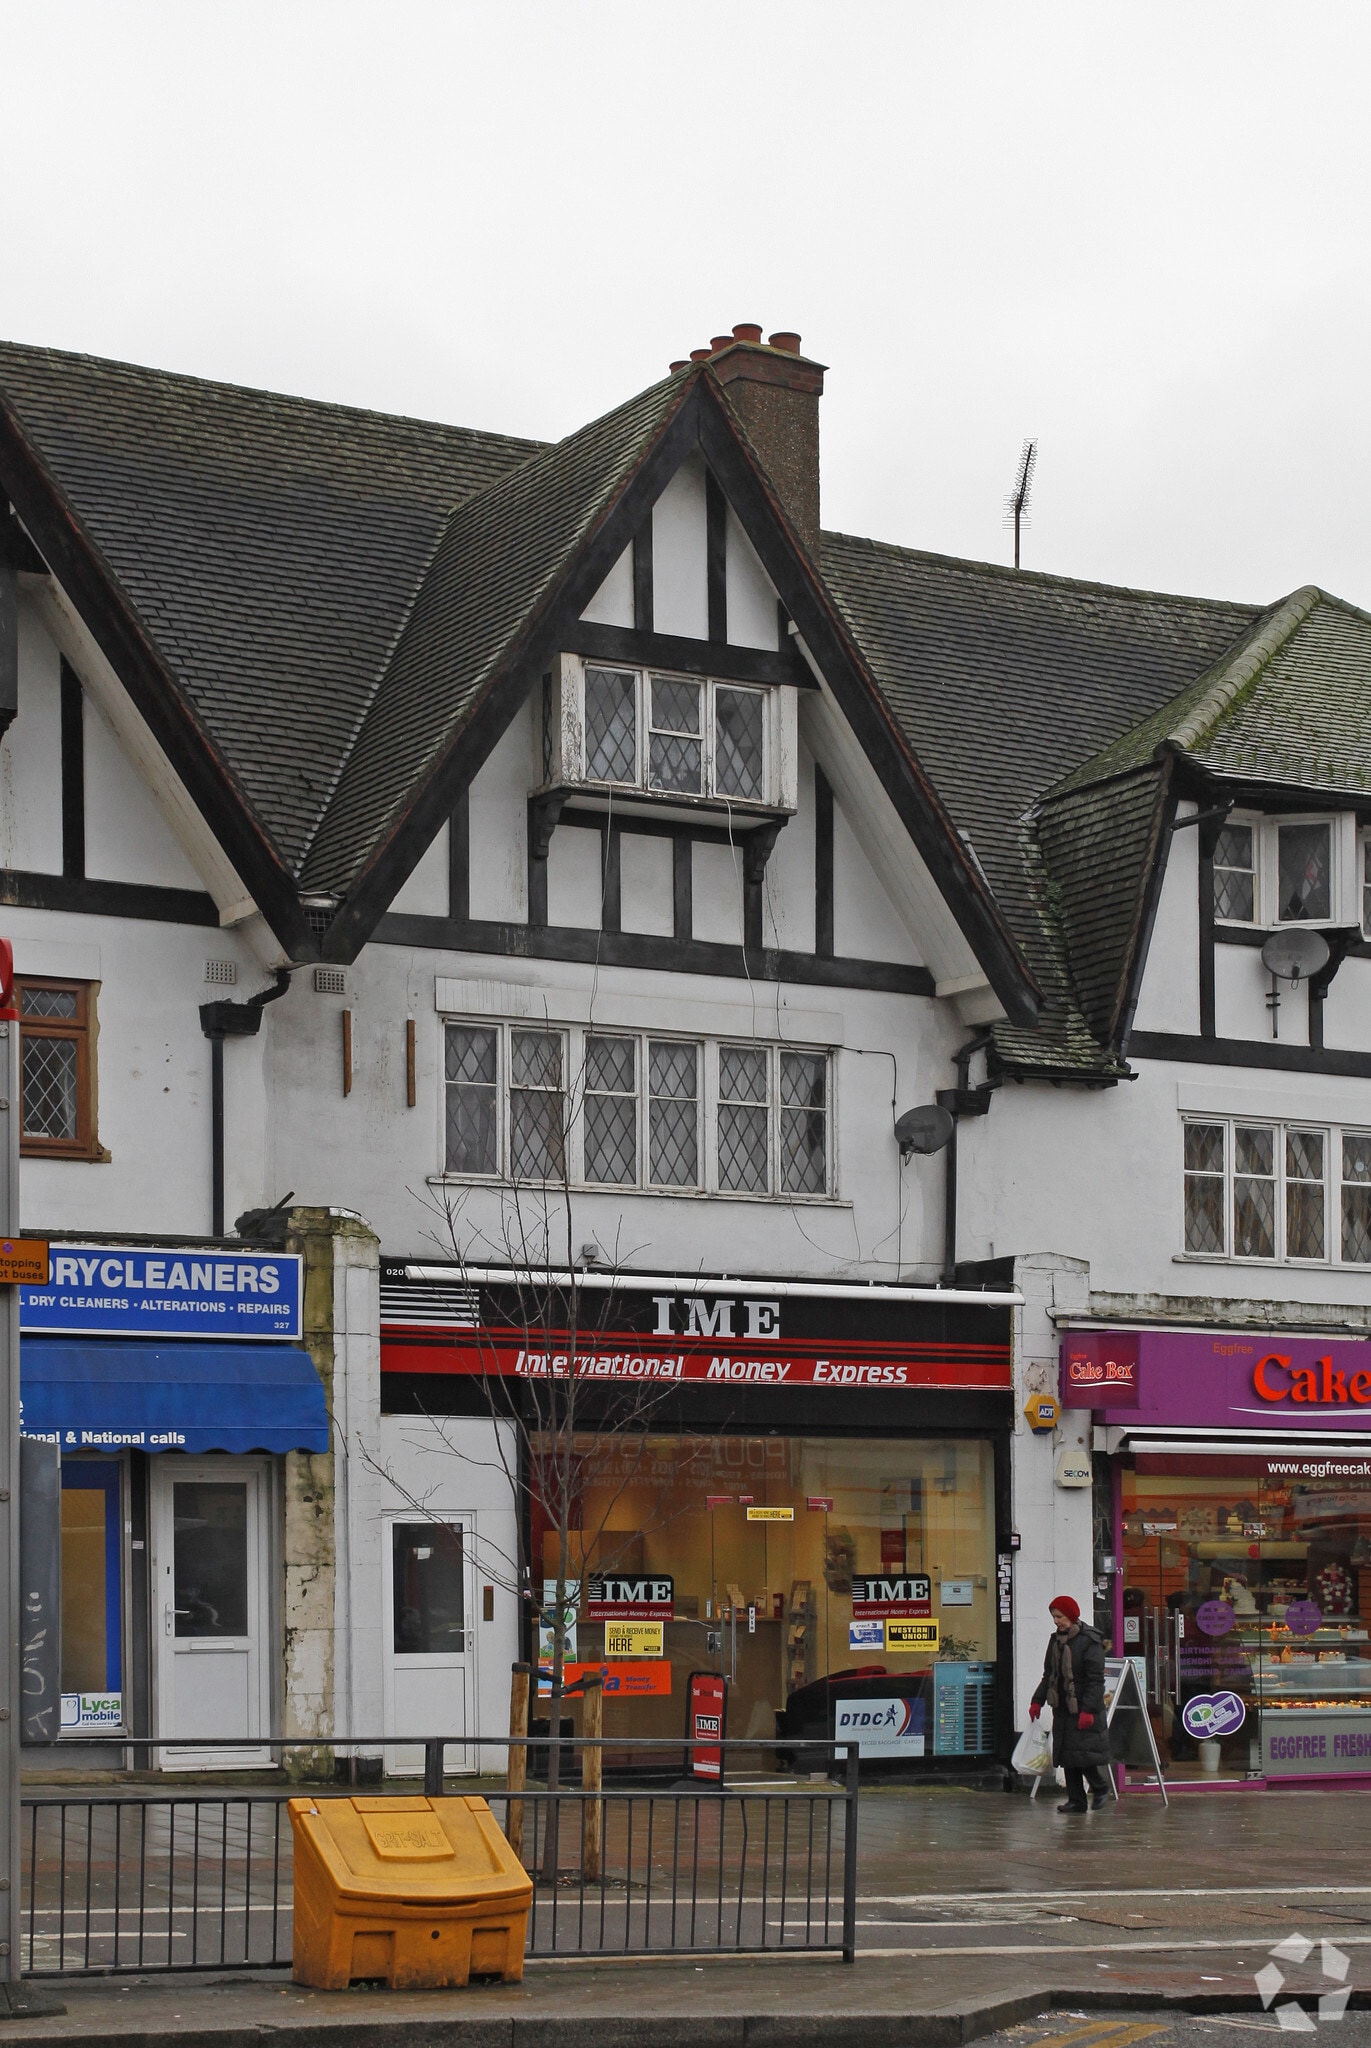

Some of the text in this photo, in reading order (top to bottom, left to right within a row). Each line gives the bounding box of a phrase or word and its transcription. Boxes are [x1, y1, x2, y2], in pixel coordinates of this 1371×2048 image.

[12, 1270, 44, 1280] buses
[29, 1295, 56, 1307] DRY
[60, 1297, 129, 1309] CLEANERS
[141, 1300, 226, 1313] ALTERATIONS
[237, 1303, 290, 1315] REPAIRS
[652, 1297, 780, 1339] IME
[1213, 1343, 1254, 1356] Eggfree
[515, 1351, 907, 1383] International Money Express
[1069, 1361, 1134, 1380] Cake Box
[1253, 1353, 1371, 1404] Cake
[1039, 1407, 1055, 1417] ADT
[65, 1431, 77, 1443] &
[81, 1431, 145, 1444] National
[150, 1431, 186, 1444] calls
[1064, 1469, 1089, 1477] SECOM
[603, 1581, 671, 1603] IME
[866, 1580, 929, 1602] IME
[629, 1610, 648, 1618] Money
[609, 1627, 621, 1635] SEND
[644, 1627, 661, 1635] MONEY
[609, 1638, 633, 1652] HERE
[601, 1666, 621, 1691] ia
[626, 1683, 656, 1692] Transfer
[82, 1697, 121, 1713] Lyca
[82, 1711, 121, 1721] mobile
[840, 1713, 883, 1726] DTDC
[700, 1719, 718, 1731] IME
[1270, 1733, 1371, 1760] EGGFREE FRESH
